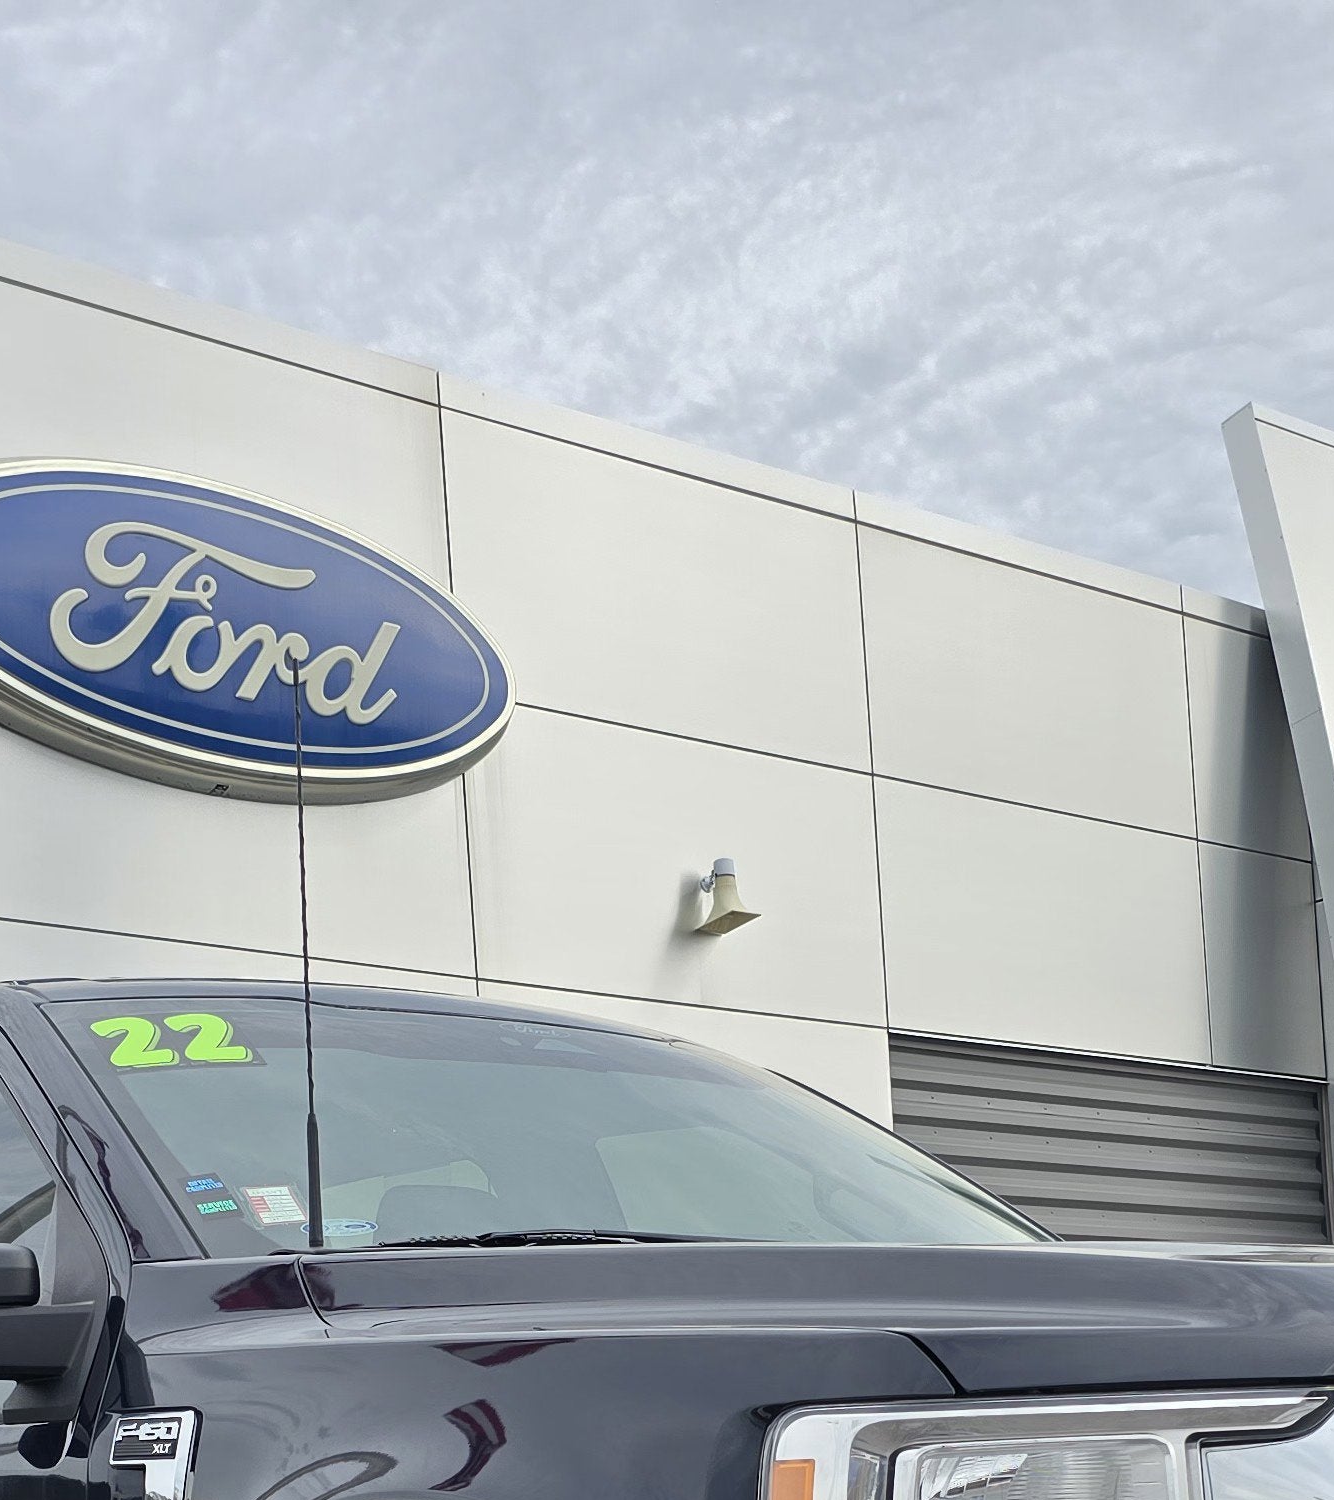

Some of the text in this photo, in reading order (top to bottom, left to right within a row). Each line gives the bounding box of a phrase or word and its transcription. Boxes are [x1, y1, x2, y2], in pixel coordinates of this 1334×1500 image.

[49, 521, 402, 726] Ford
[89, 1013, 254, 1068] 22
[151, 1443, 172, 1455] XLT
